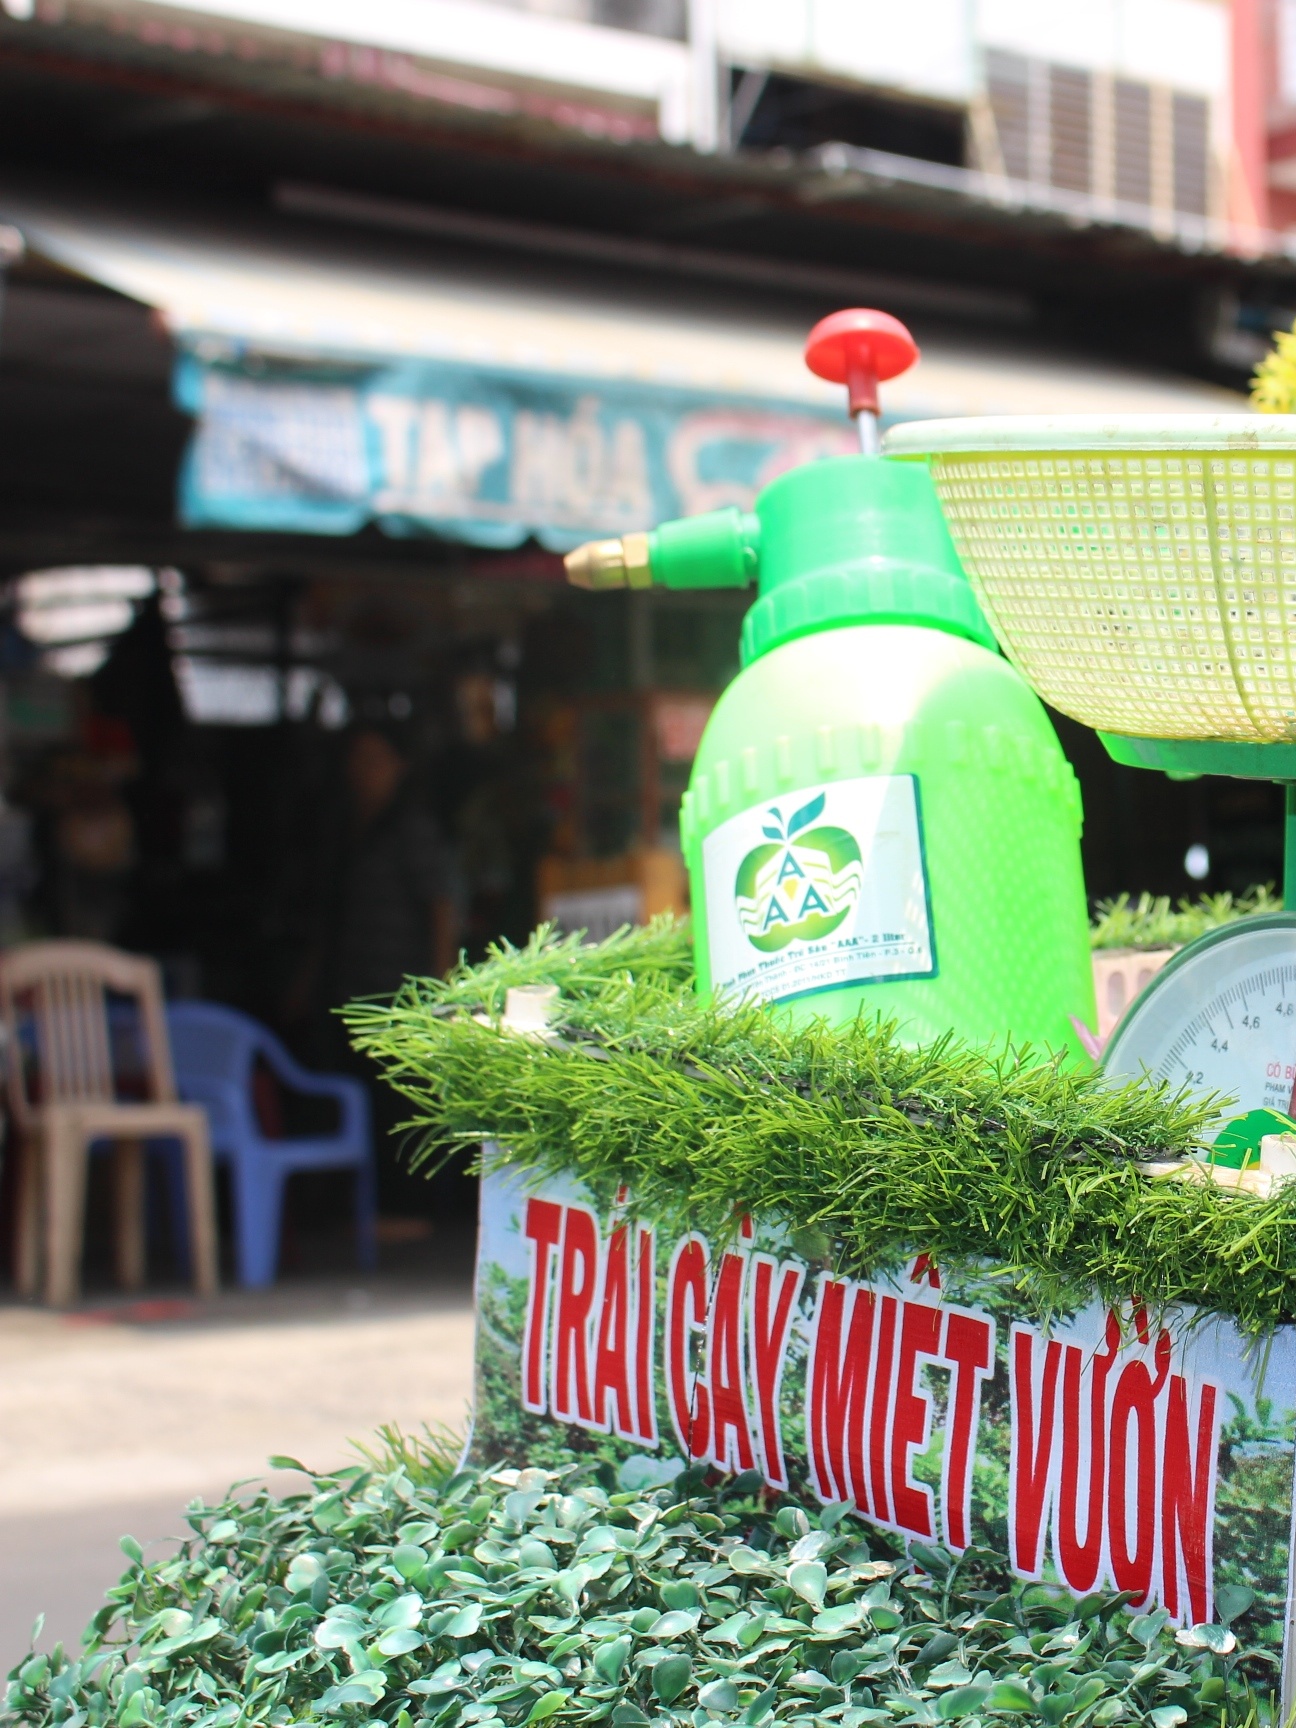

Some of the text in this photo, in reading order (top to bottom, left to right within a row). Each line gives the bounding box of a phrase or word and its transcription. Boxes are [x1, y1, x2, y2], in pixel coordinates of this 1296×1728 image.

[1242, 1015, 1261, 1030] 4,6
[1210, 1038, 1229, 1053] 4,4
[523, 1184, 656, 1442] TRÁI
[668, 1200, 801, 1484] CÂY
[1013, 1294, 1217, 1626] VƯỜN
